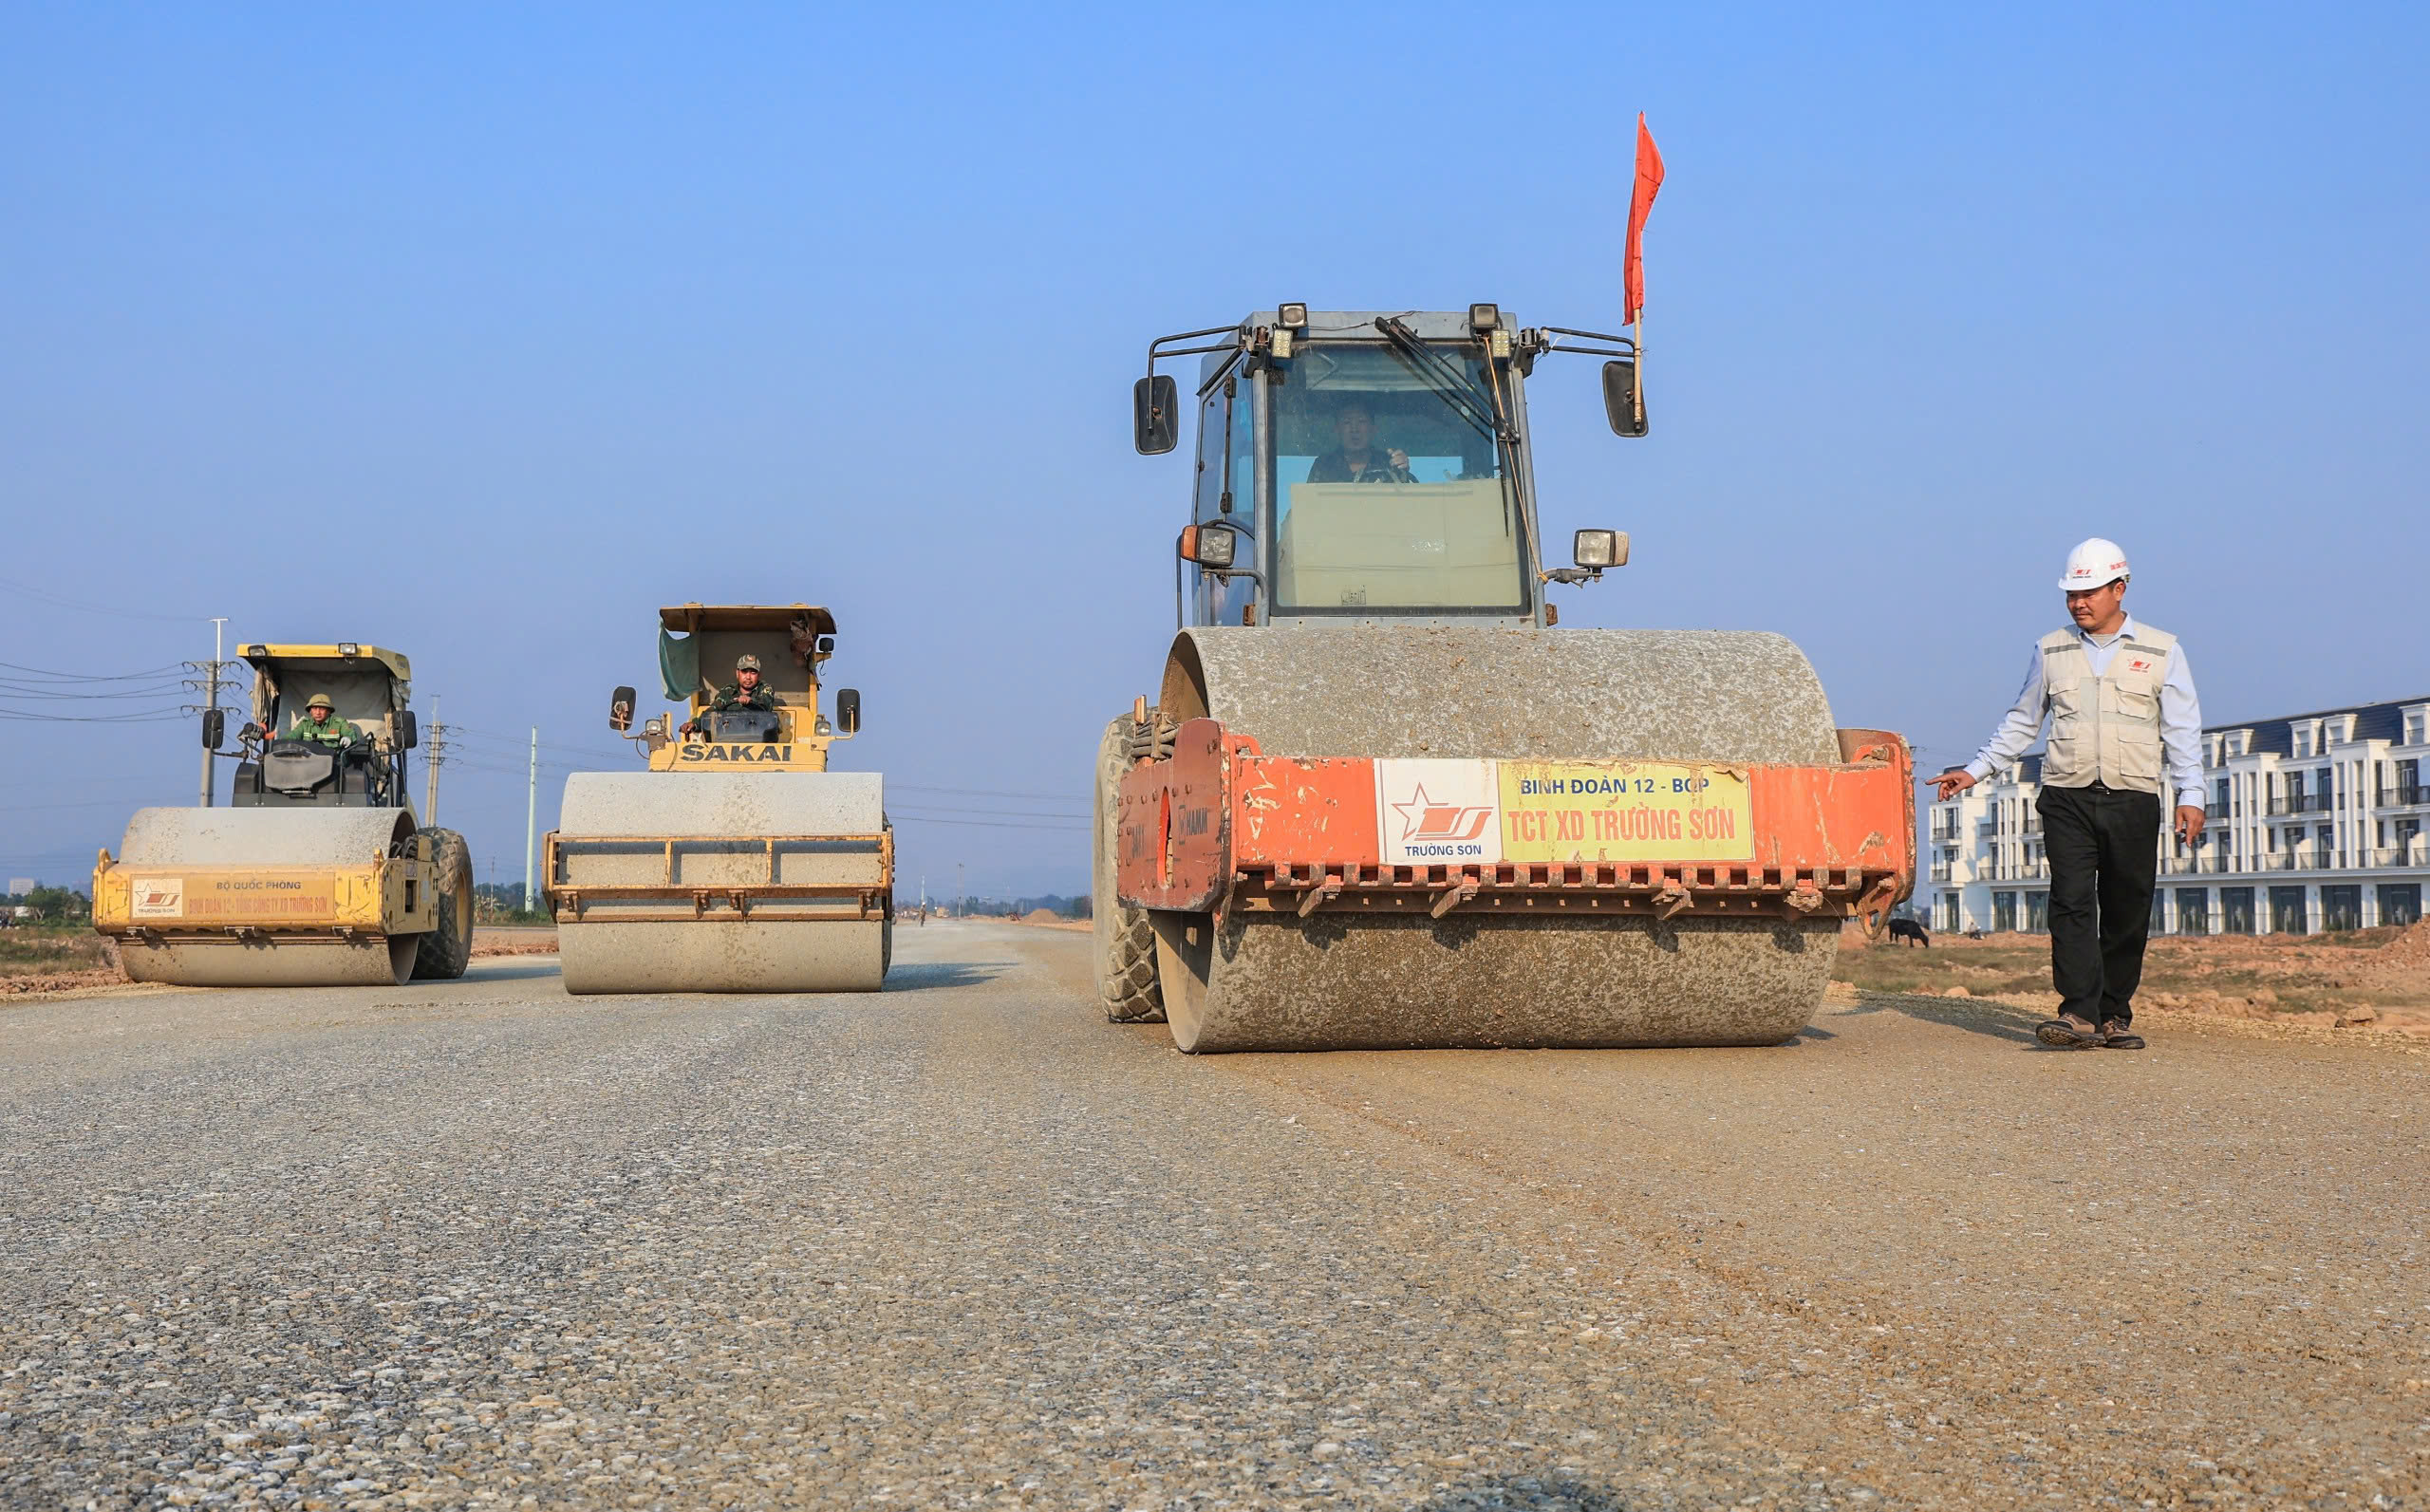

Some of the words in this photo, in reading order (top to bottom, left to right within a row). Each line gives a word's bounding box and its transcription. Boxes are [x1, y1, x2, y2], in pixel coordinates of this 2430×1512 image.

[681, 744, 792, 761] SAKAI
[1521, 779, 1564, 793] BINH
[1571, 775, 1627, 793] ĐOÀN
[1634, 778, 1654, 793] 12
[1507, 810, 1547, 842] TCT
[1555, 810, 1585, 841] XD
[1591, 801, 1682, 841] TRƯỜNG
[1690, 806, 1736, 841] SƠN
[1405, 843, 1454, 856] TRƯỜNG
[1457, 845, 1482, 856] SƠN
